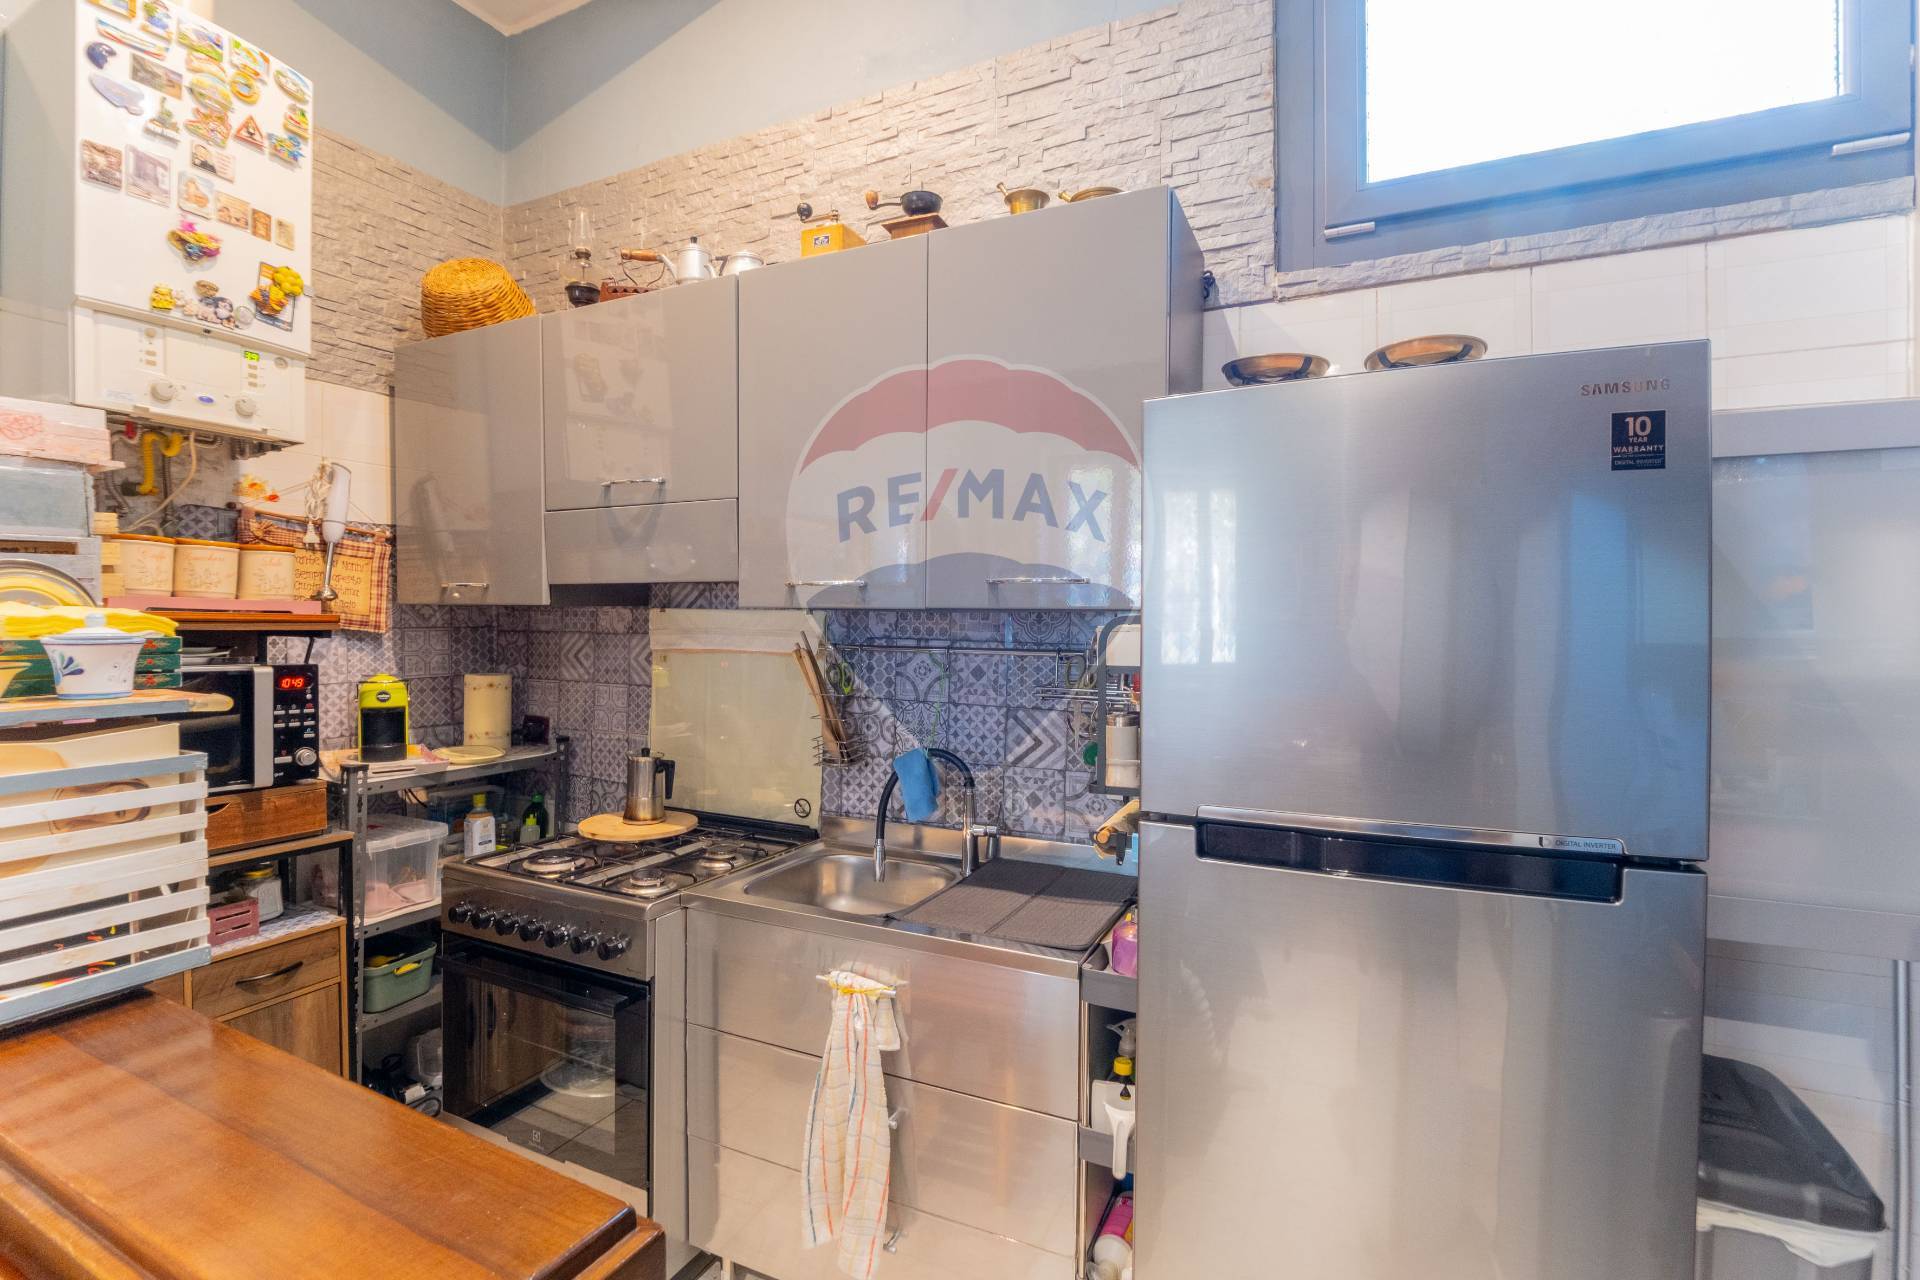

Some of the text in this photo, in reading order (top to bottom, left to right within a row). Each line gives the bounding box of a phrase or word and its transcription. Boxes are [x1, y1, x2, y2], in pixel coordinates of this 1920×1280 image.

[1581, 379, 1670, 396] SAMSUNG
[1624, 416, 1652, 436] 10
[1613, 444, 1665, 454] WARRANTY
[1555, 839, 1616, 850] DIGITAL INVERTER
